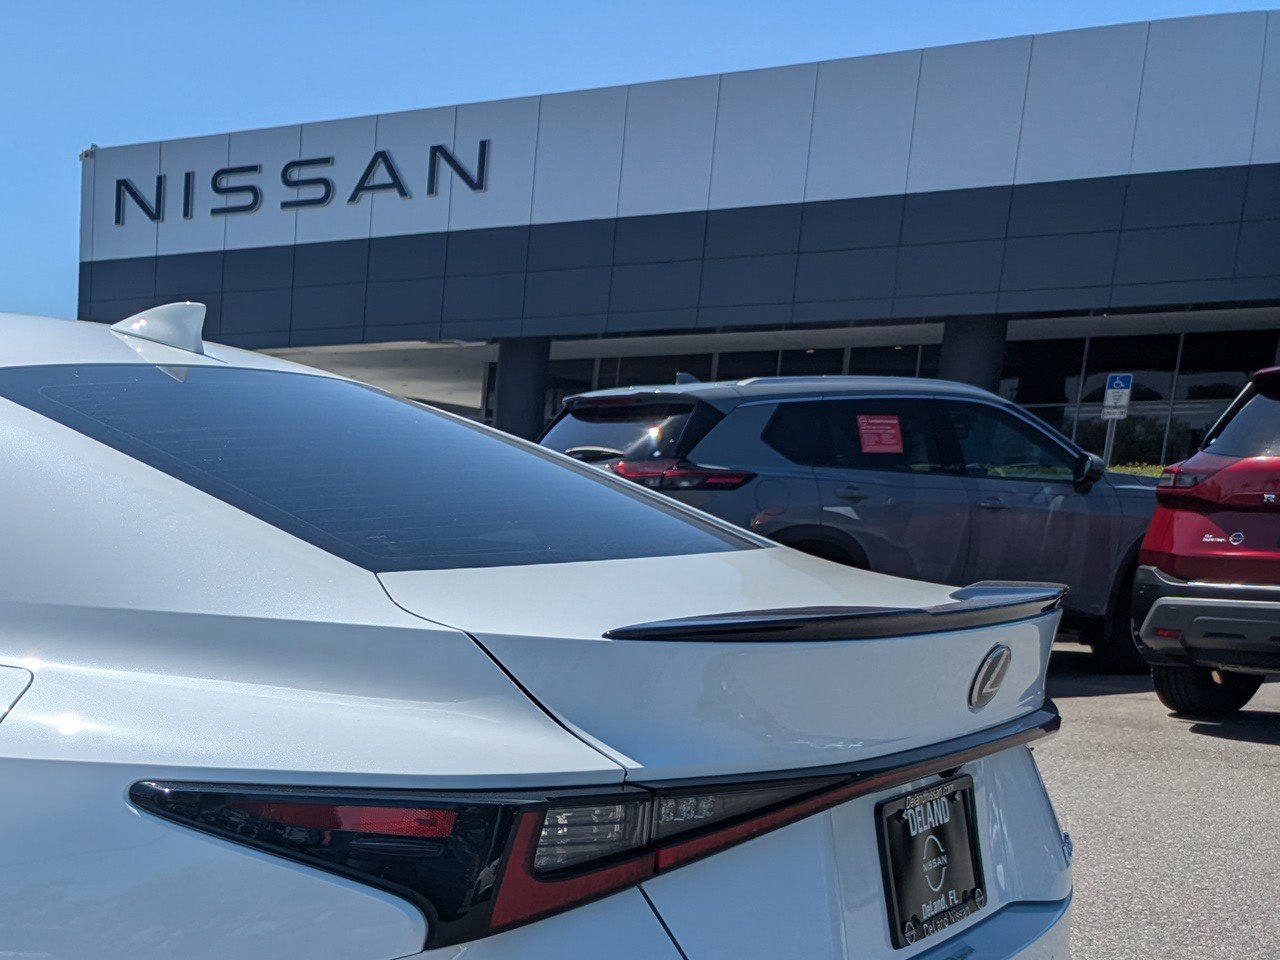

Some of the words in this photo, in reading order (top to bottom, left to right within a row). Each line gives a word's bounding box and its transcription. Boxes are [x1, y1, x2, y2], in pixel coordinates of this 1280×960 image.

[114, 139, 490, 226] NISSAN
[906, 796, 951, 837] DELAND
[922, 854, 948, 872] NISSAN
[948, 889, 959, 905] FL
